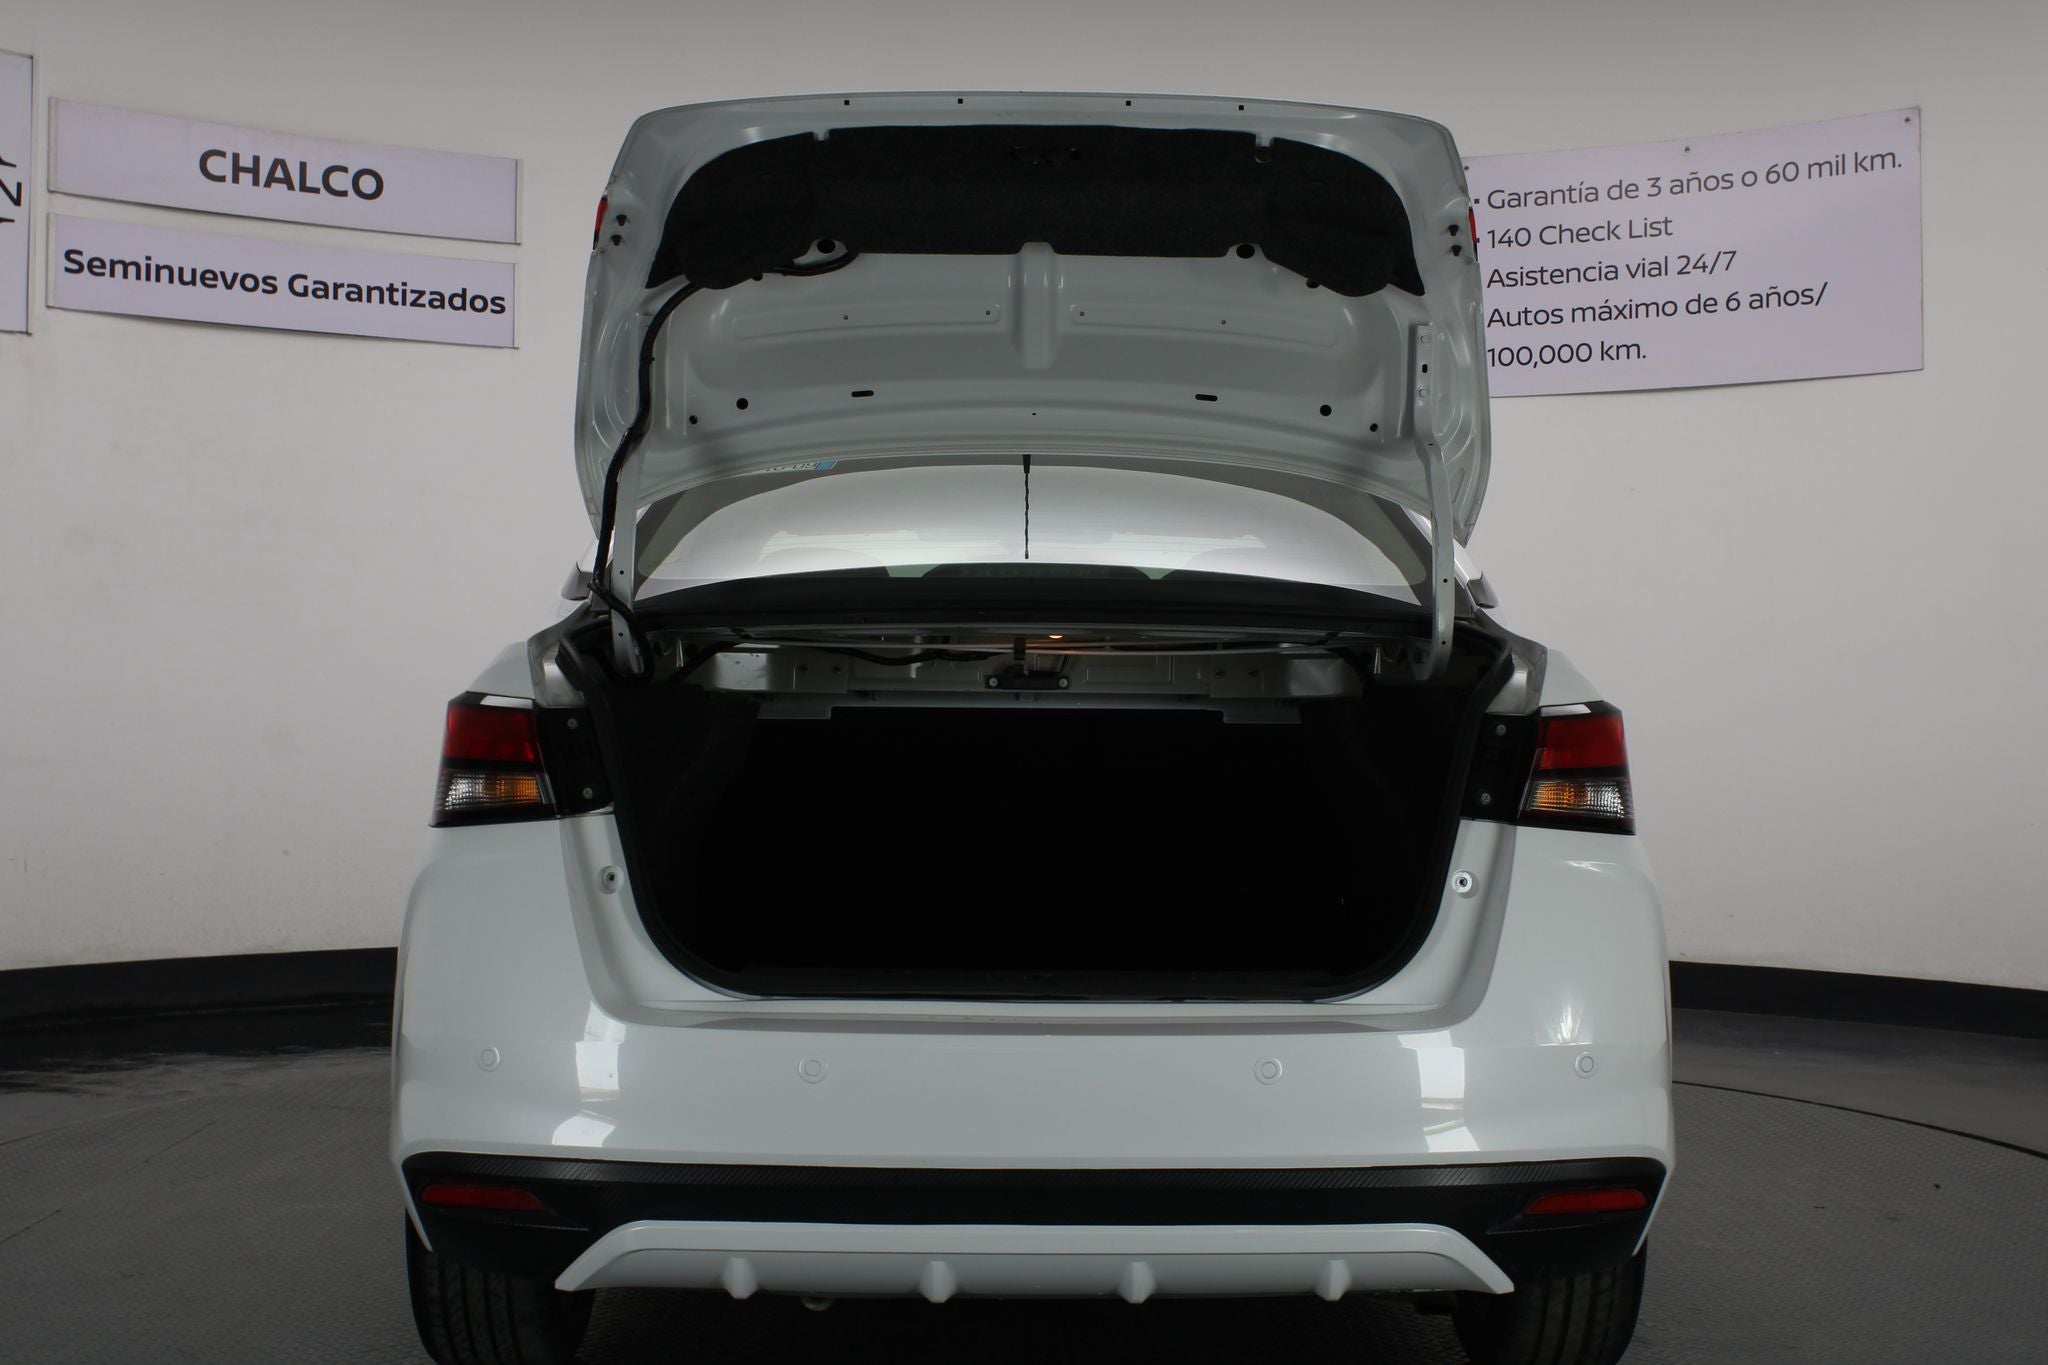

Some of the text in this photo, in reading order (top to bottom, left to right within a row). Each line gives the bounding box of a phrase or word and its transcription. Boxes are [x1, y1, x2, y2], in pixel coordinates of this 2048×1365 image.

[199, 149, 384, 200] CHALCO
[1487, 151, 1902, 210] Garantía de 3 años o 60 mil km.
[1487, 216, 1674, 249] 140 Check List
[64, 249, 507, 315] Seminuevos Garantizados
[1487, 250, 1737, 289] Asistencia vial 24/7
[1487, 282, 1829, 329] Autos máximo de 6 años/
[1487, 340, 1647, 369] 100,000 km.
